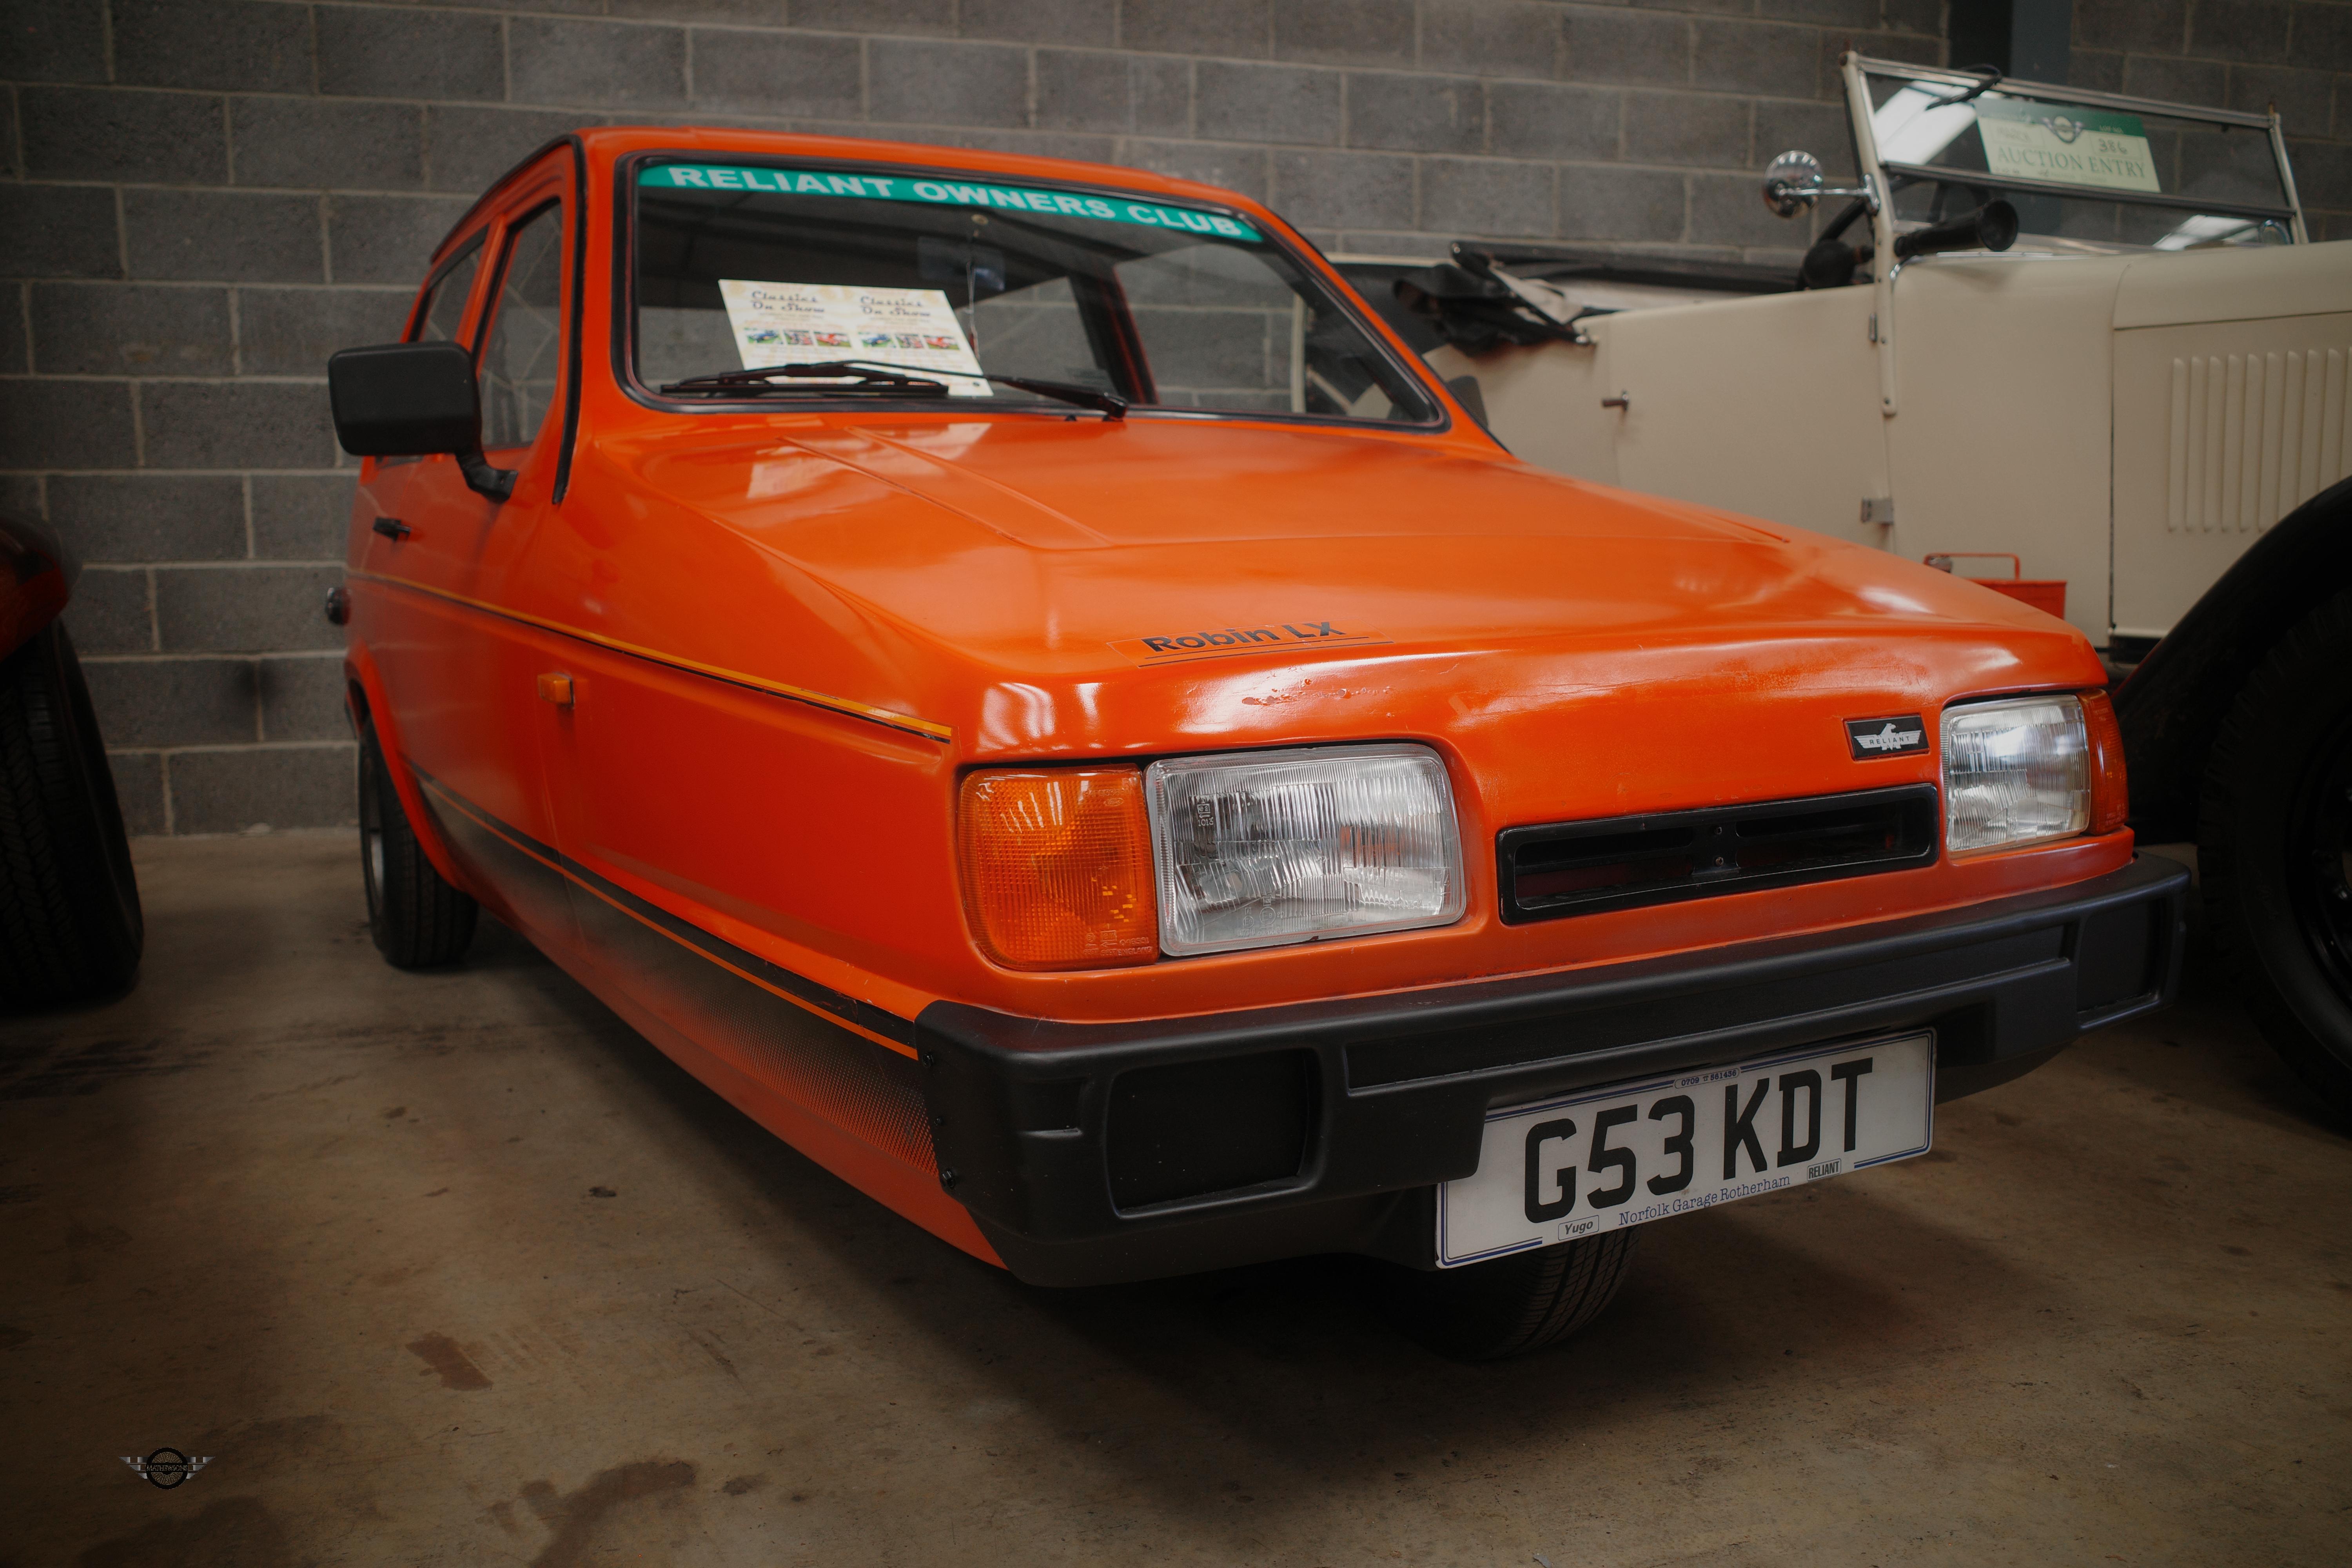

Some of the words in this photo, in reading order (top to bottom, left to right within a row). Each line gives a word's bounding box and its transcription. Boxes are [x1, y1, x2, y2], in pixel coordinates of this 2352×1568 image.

[2098, 138, 2127, 154] 386
[1998, 147, 2083, 170] AUCTION
[2088, 156, 2145, 178] ENTRY
[668, 167, 893, 196] RELIANT
[913, 181, 1116, 218] OWNERS
[1127, 205, 1243, 236] CLUB
[751, 290, 818, 303] Classics
[860, 296, 924, 307] Classics
[750, 300, 775, 310] On
[780, 302, 825, 313] Show
[860, 305, 883, 315] On
[889, 307, 931, 317] Show
[1141, 628, 1279, 652] Robin
[1281, 621, 1347, 638] LX
[1869, 736, 1910, 745] RELIANT
[1198, 817, 1214, 827] 1013
[1681, 1077, 1700, 1086] 0709
[1710, 1070, 1737, 1081] 561436
[1524, 1095, 1695, 1223] G53
[1723, 1057, 1873, 1180] KDT
[1808, 1161, 1840, 1179] RELIANT
[1618, 1203, 1670, 1226] Norfolk
[1672, 1192, 1717, 1211] Garage
[1720, 1176, 1791, 1201] Rotherham
[1564, 1220, 1593, 1235] Yugo
